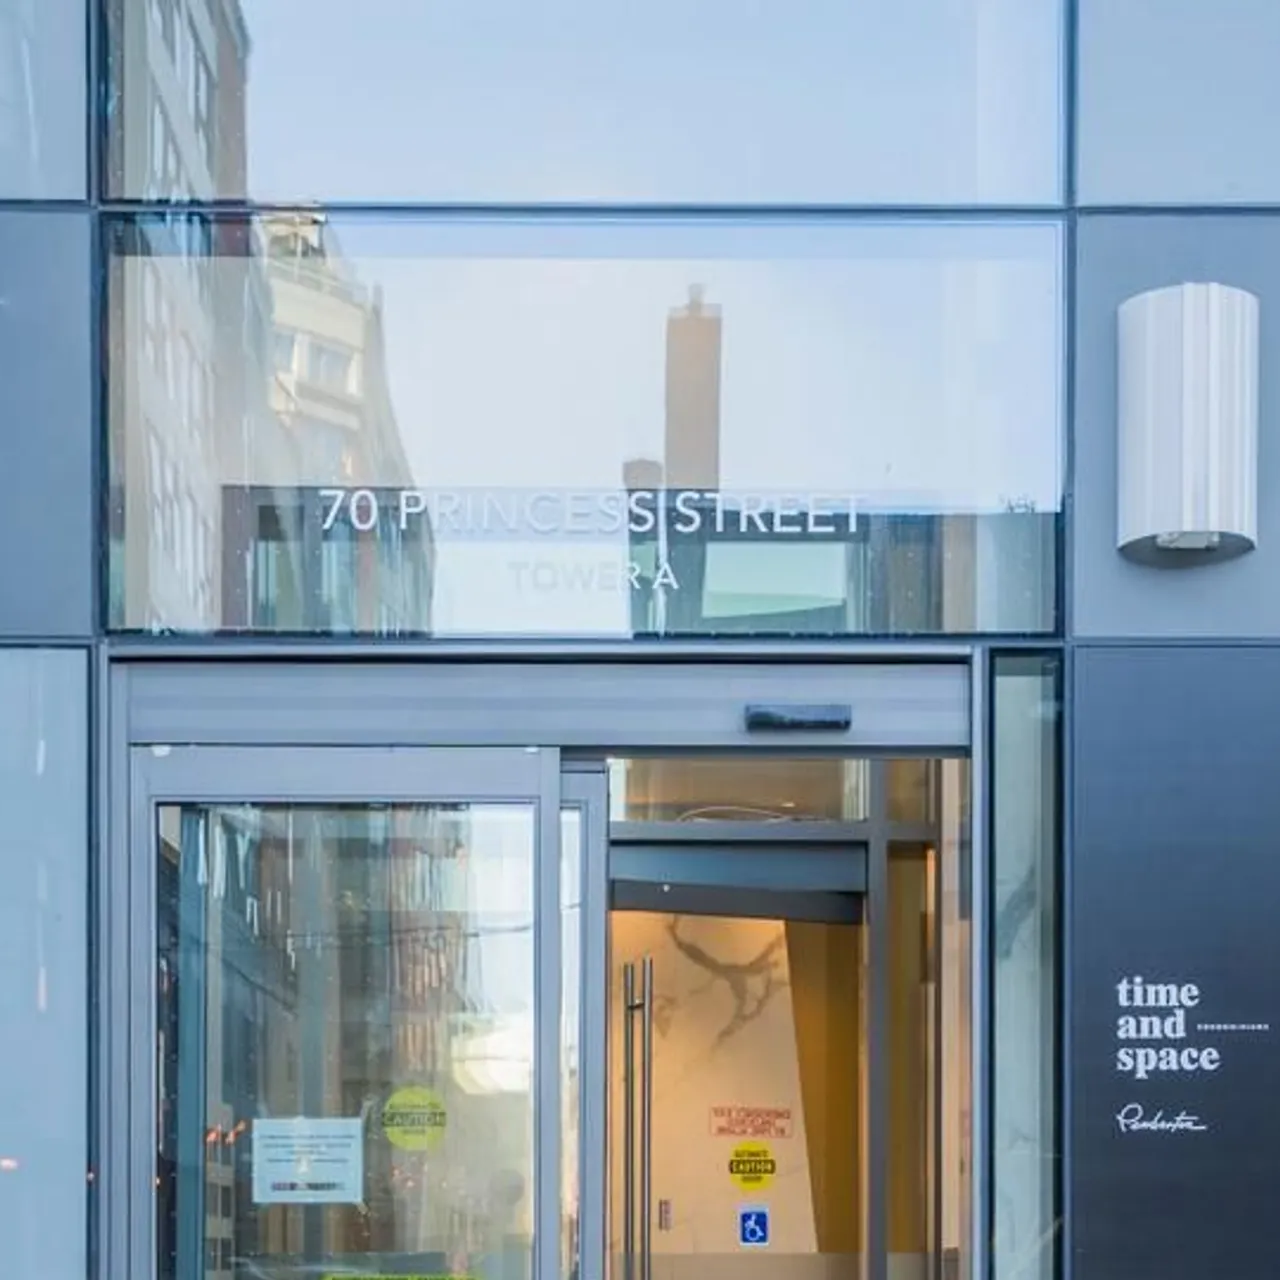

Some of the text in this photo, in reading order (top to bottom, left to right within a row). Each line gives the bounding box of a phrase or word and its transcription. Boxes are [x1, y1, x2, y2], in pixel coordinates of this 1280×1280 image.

[320, 489, 869, 533] 70 PRINCESS STREET
[508, 560, 680, 590] TOWER A
[1115, 975, 1201, 1008] time
[1116, 1008, 1187, 1039] and
[1116, 1047, 1221, 1080] space
[732, 1160, 773, 1174] CAUTION
